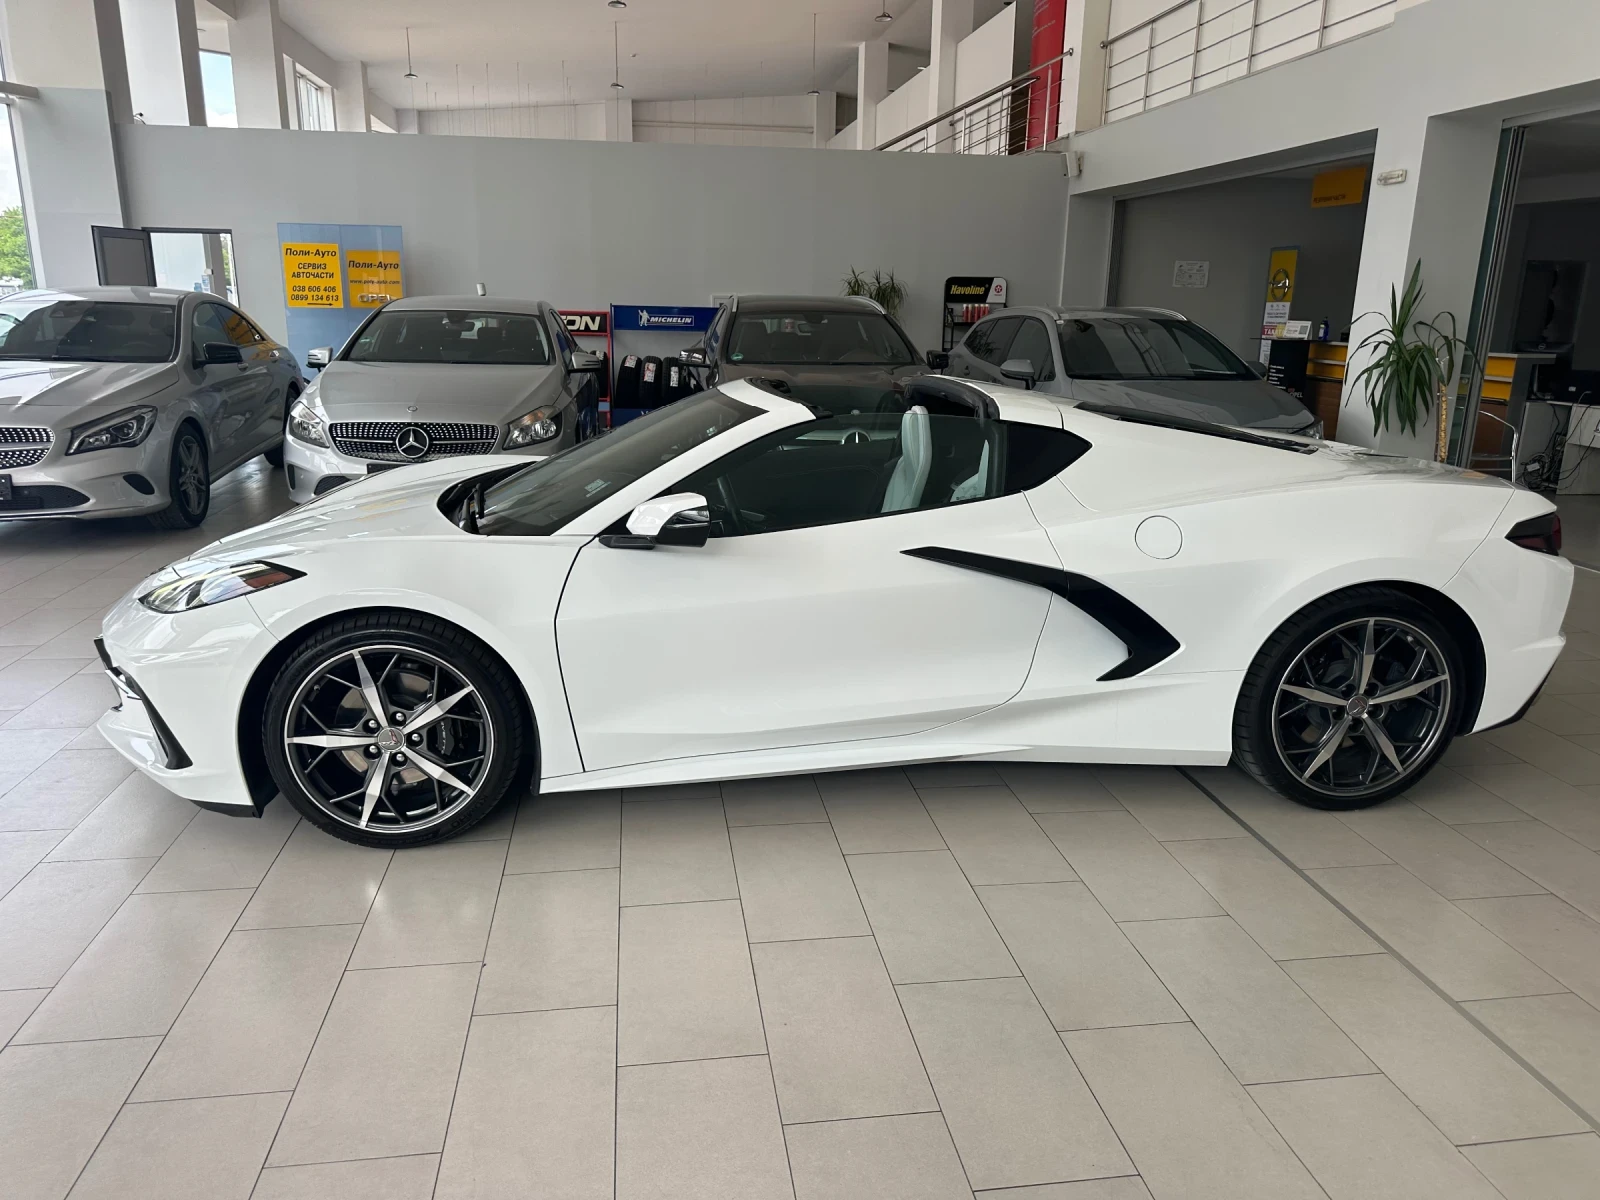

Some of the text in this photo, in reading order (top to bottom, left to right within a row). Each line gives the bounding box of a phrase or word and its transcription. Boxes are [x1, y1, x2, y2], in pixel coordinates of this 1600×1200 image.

[285, 247, 337, 258] Поли-Ауто
[297, 262, 327, 270] СЕРВИЗ
[348, 260, 399, 270] Поли-Ауто
[291, 271, 334, 279] АВТОЧАСТИ
[323, 285, 337, 293] 406
[950, 284, 985, 295] Havoline
[325, 294, 339, 302] 613
[649, 316, 692, 324] MICHELIN
